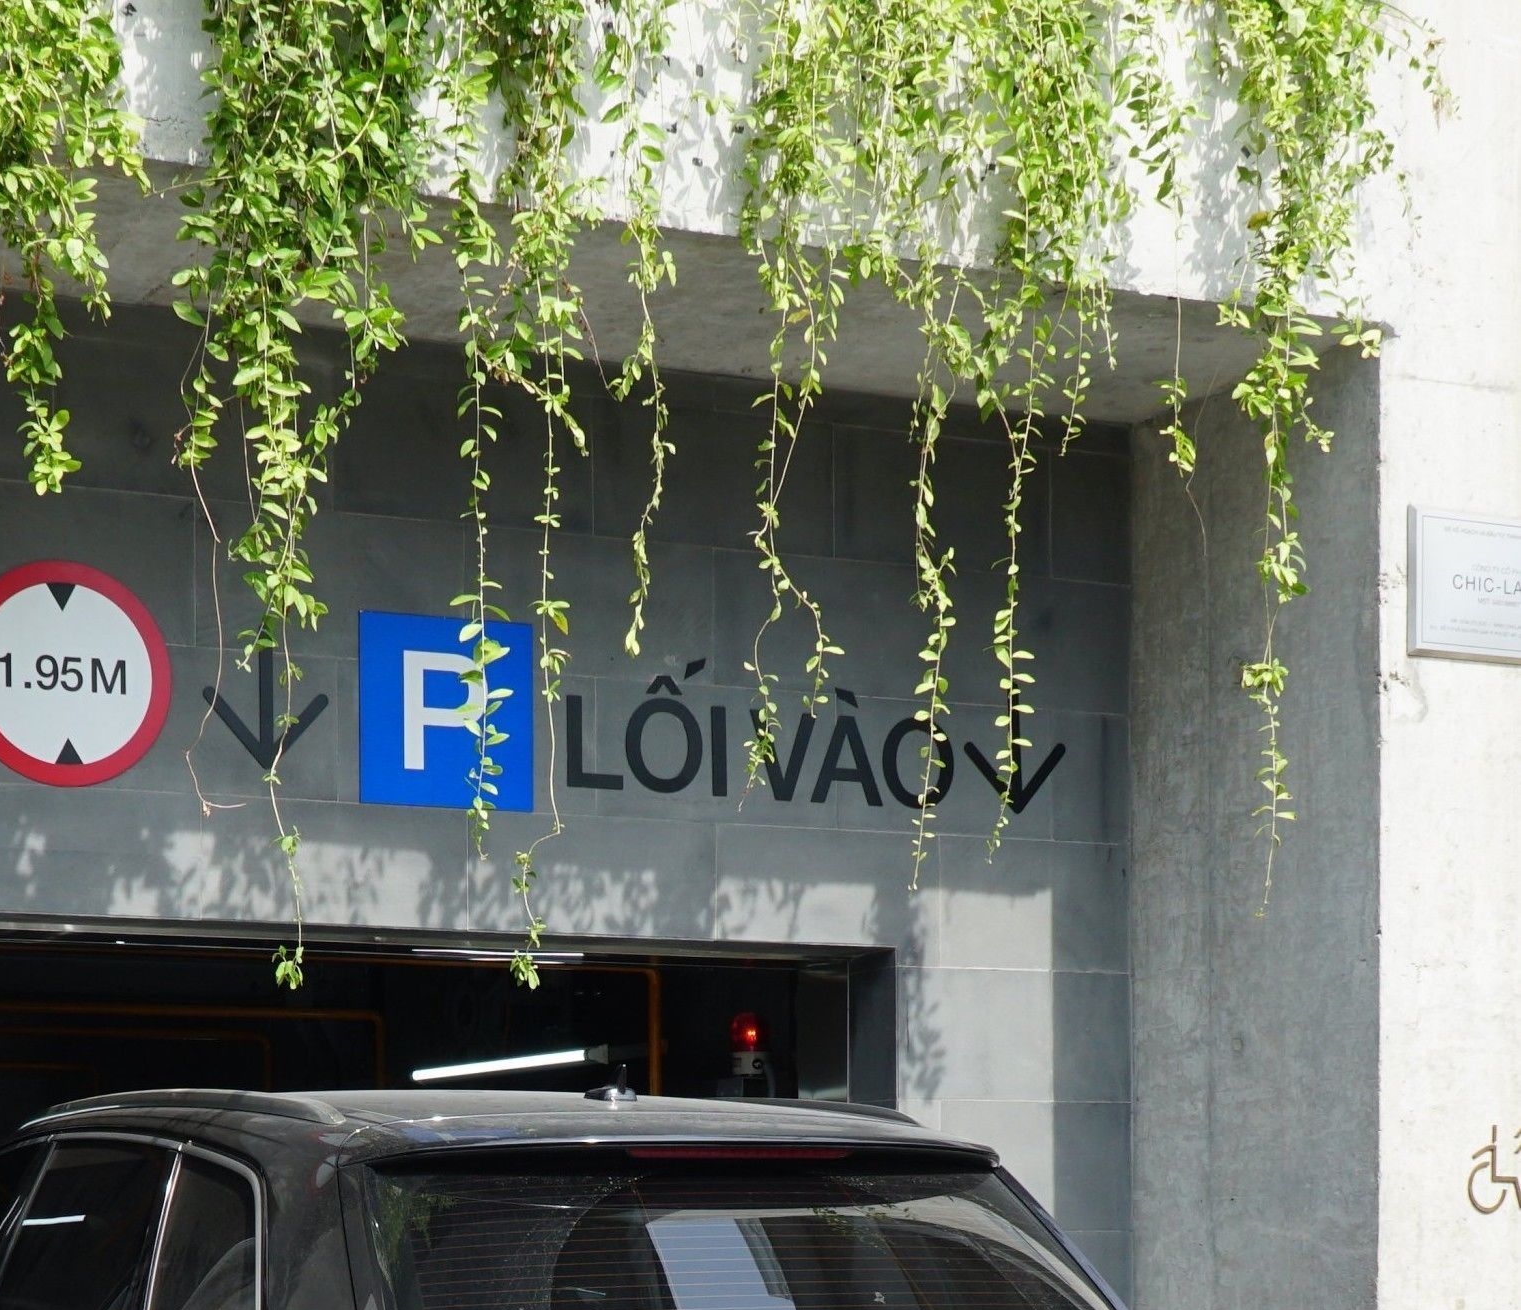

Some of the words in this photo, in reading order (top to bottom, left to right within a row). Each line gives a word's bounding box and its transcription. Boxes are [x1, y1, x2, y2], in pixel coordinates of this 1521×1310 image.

[402, 649, 488, 771] P
[565, 658, 728, 798] LỐI
[750, 687, 955, 809] VÀO
